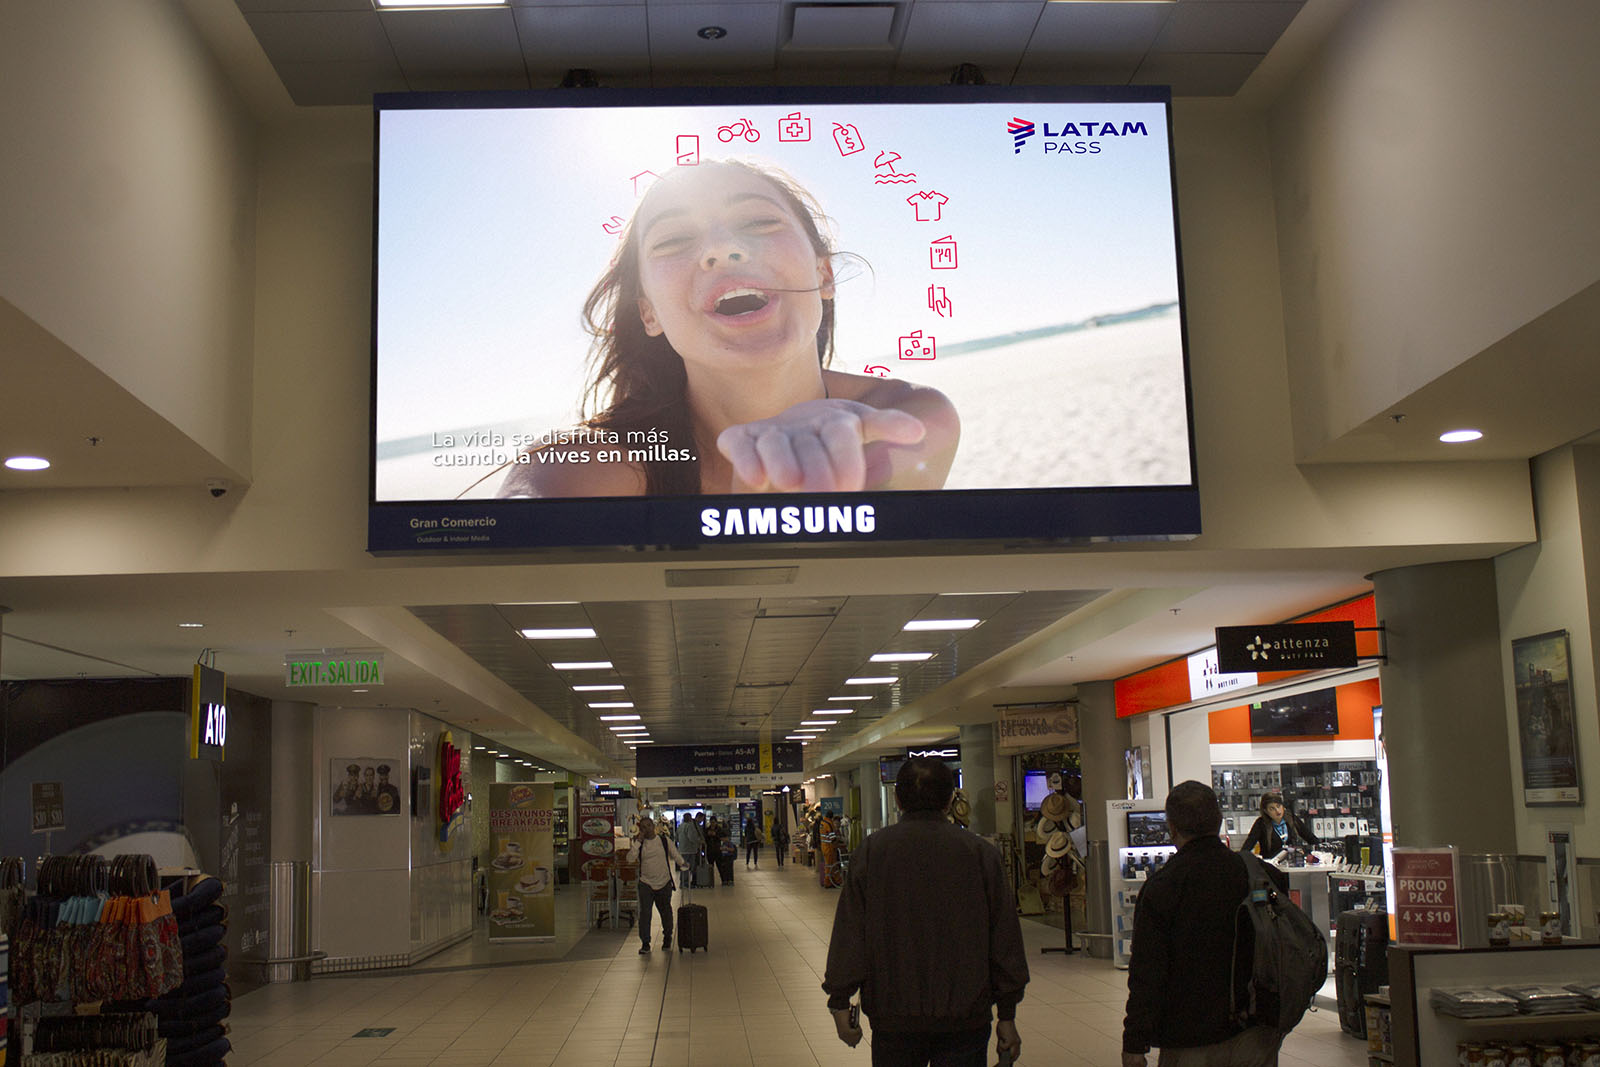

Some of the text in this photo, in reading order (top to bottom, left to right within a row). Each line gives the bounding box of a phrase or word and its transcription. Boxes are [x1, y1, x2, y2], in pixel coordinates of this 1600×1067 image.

[1043, 122, 1149, 137] LATAM
[1044, 141, 1102, 154] PASS
[431, 427, 669, 448] La vida se disfruta más
[432, 445, 698, 466] cuando la vives en millas.
[409, 516, 497, 529] Gran Comercio
[700, 505, 876, 536] SAMSUNG
[416, 535, 442, 543] Outdoor
[1273, 637, 1330, 650] attenza
[290, 660, 380, 685] EXIT SALIDA
[204, 702, 227, 747] A10
[1000, 727, 1049, 737] DEL CACAO
[735, 762, 756, 771] B1-B2
[490, 809, 553, 818] DESAYUNOS
[581, 806, 613, 815] FAMIGLIA
[491, 818, 552, 827] BREAKFAST
[1399, 879, 1447, 892] PROMO
[1408, 891, 1443, 903] PACK
[1402, 910, 1451, 923] 4 x $10
